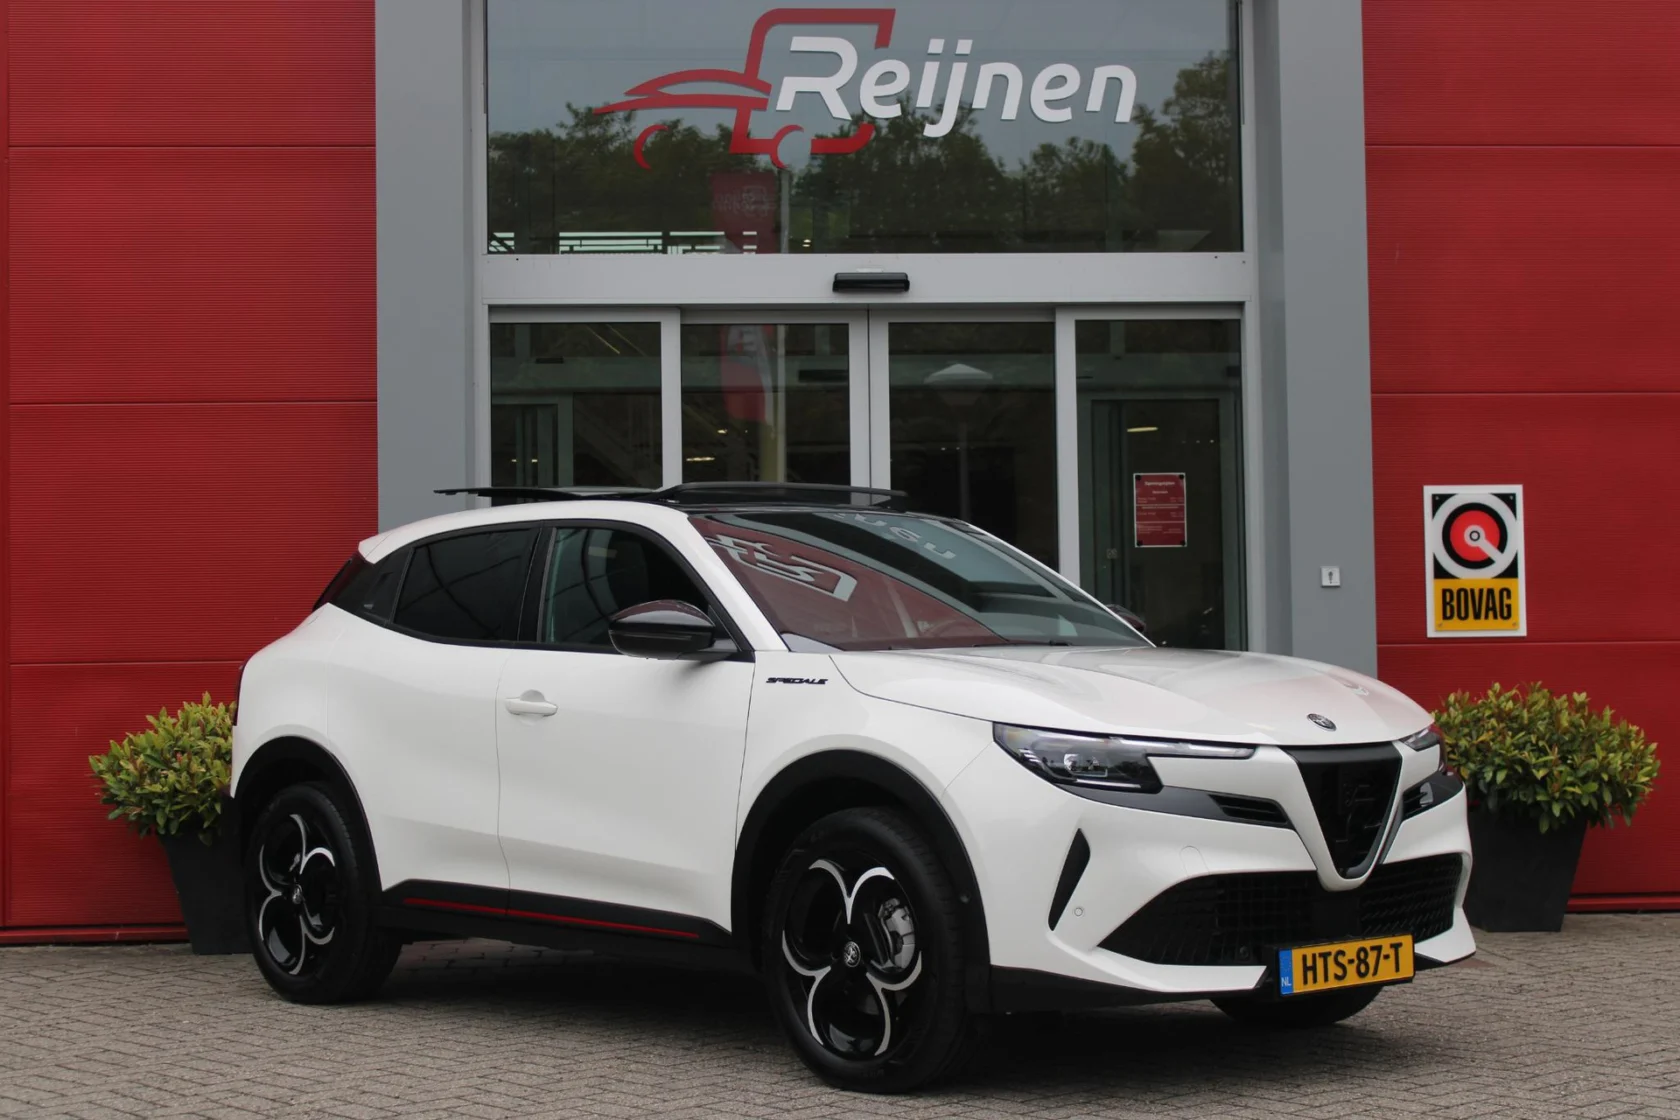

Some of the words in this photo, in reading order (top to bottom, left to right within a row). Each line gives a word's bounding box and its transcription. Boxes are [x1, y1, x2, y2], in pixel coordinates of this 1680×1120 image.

[776, 36, 1137, 137] Reijnen
[1442, 588, 1512, 620] BOVAG
[1281, 978, 1291, 987] NL
[1302, 943, 1403, 985] HTS-87-T
